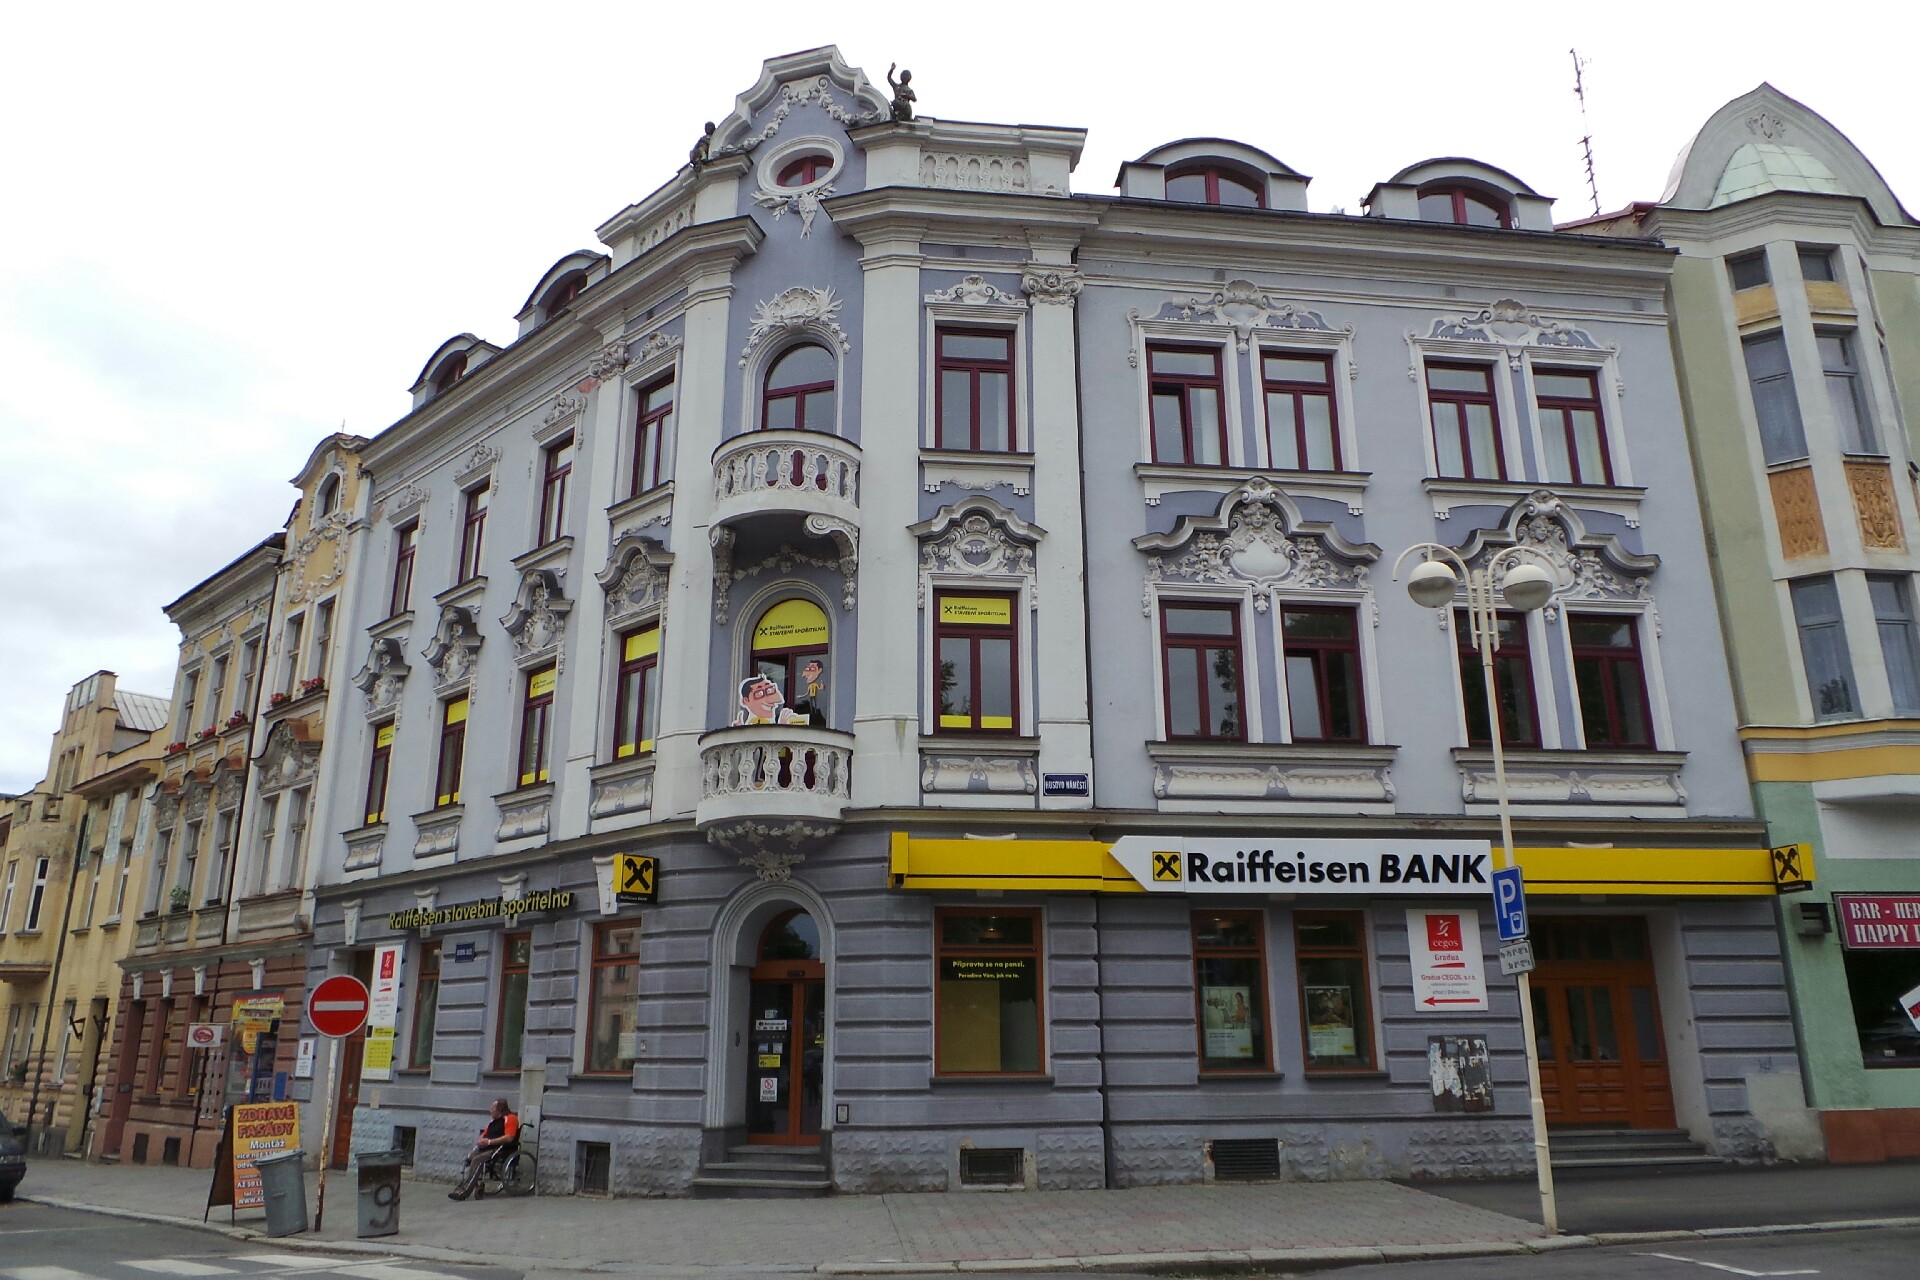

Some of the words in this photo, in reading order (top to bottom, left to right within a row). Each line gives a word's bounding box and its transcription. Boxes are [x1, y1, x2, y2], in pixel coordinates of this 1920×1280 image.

[1045, 780, 1065, 790] HUSOVO
[1065, 779, 1087, 790] NÁMĚSTÍ
[1187, 849, 1370, 884] Raiffeisen
[1379, 853, 1488, 884] BANK
[1498, 878, 1516, 918] P
[390, 908, 443, 929] Raiffeisen
[501, 888, 571, 917] spořitelna
[1849, 902, 1882, 919] BAR
[1854, 924, 1910, 943] HAPPY
[1432, 940, 1459, 949] cegos
[952, 960, 984, 969] Připravte
[1434, 953, 1460, 961] Gradua
[238, 1104, 295, 1123] ZDRAVÉ
[238, 1121, 294, 1138] FASÁDY
[250, 1140, 286, 1150] Montáž
